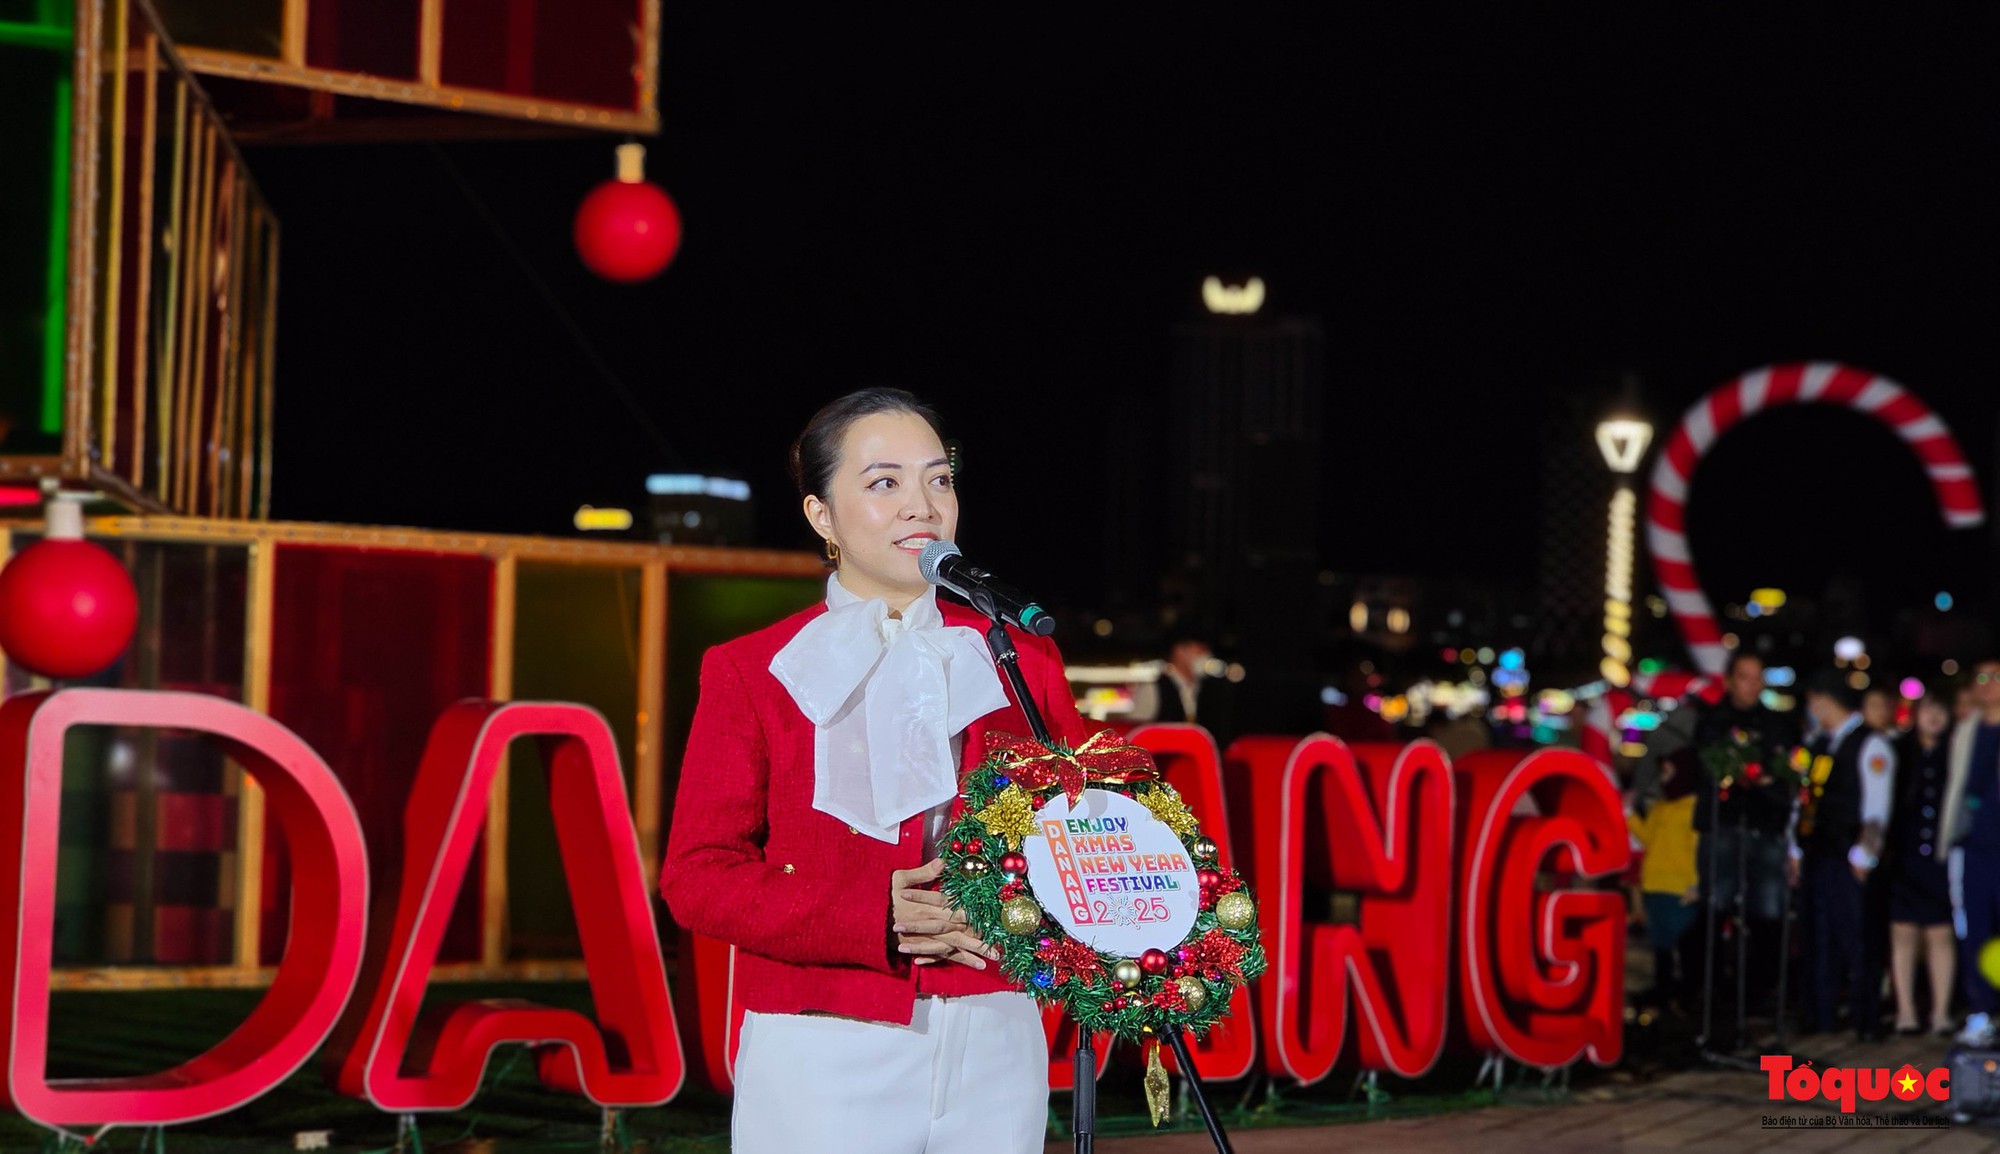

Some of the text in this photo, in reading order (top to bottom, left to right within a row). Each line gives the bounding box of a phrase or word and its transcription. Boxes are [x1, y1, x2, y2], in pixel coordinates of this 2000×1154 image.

[1066, 817, 1128, 834] ENJOY
[1071, 835, 1135, 854] XMAS
[1078, 853, 1188, 874] NEW YEAR
[1086, 875, 1179, 893] FESTIVAL
